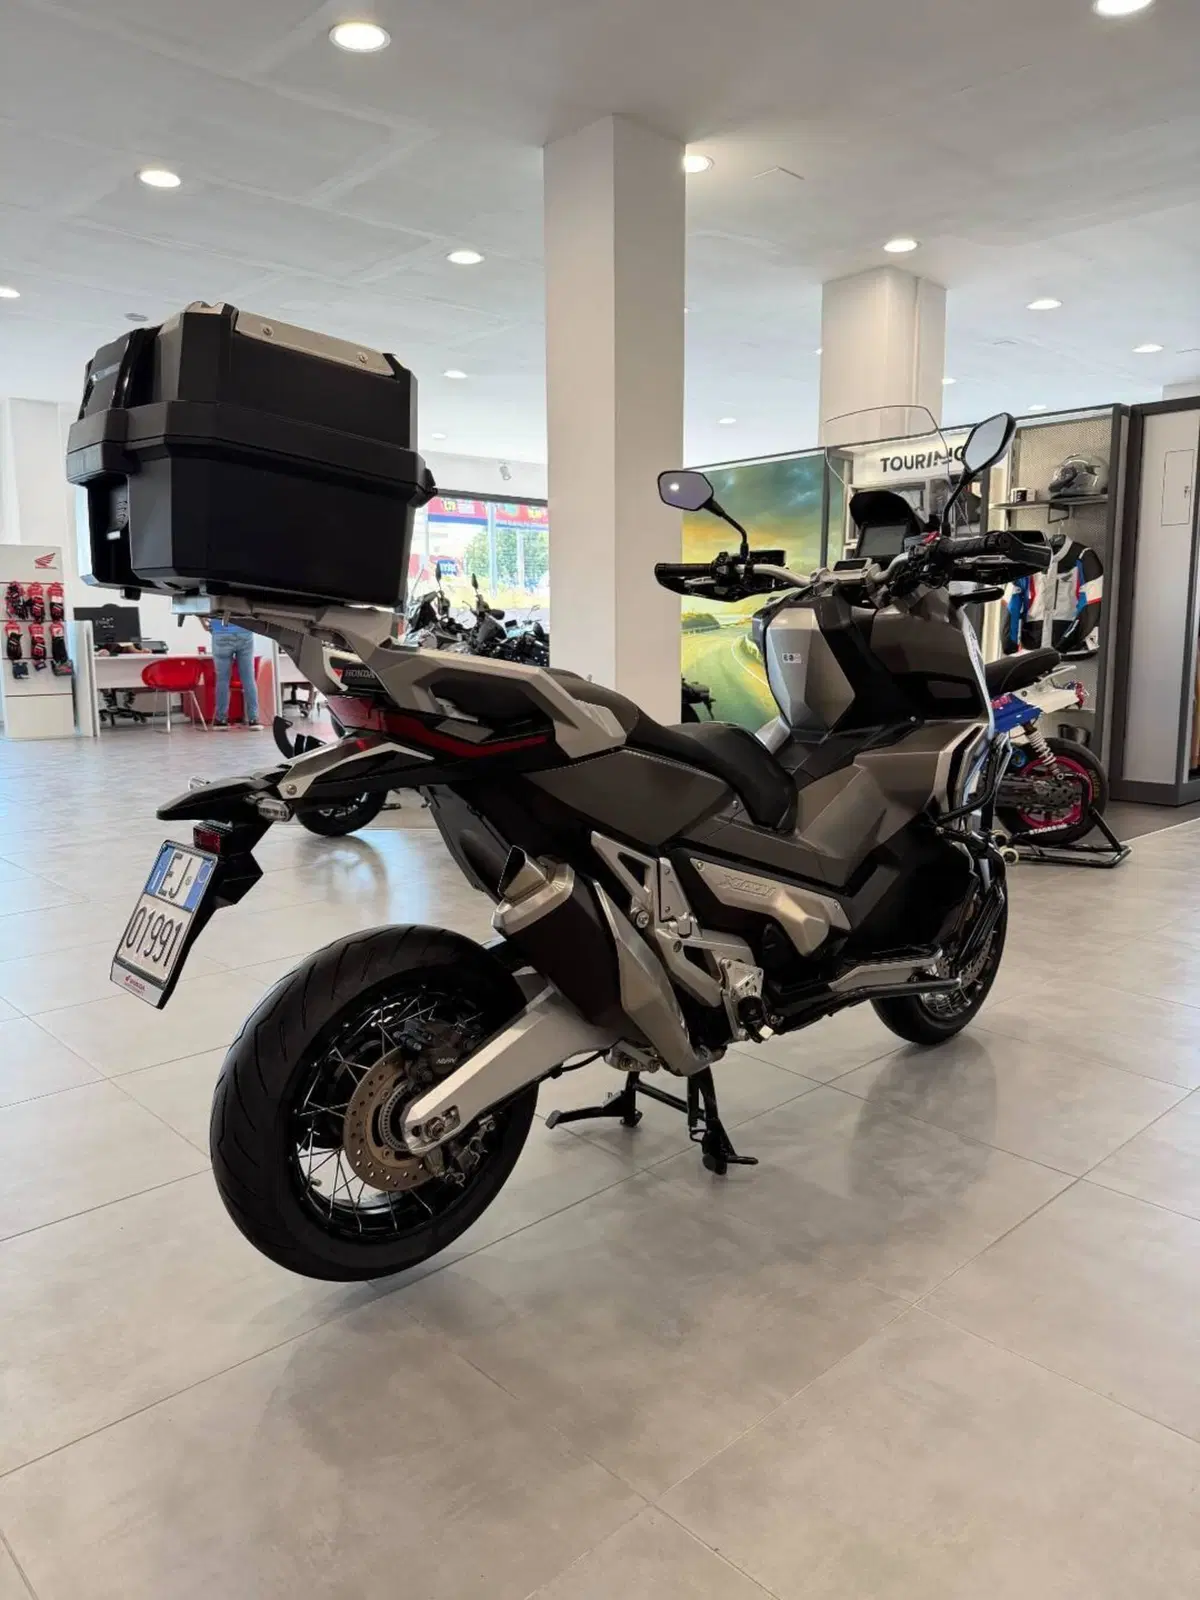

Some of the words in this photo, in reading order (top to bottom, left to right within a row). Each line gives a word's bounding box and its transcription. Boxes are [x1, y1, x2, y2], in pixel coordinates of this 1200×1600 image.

[345, 668, 376, 679] HONDA
[158, 852, 192, 898] EJ
[126, 906, 183, 967] 01991
